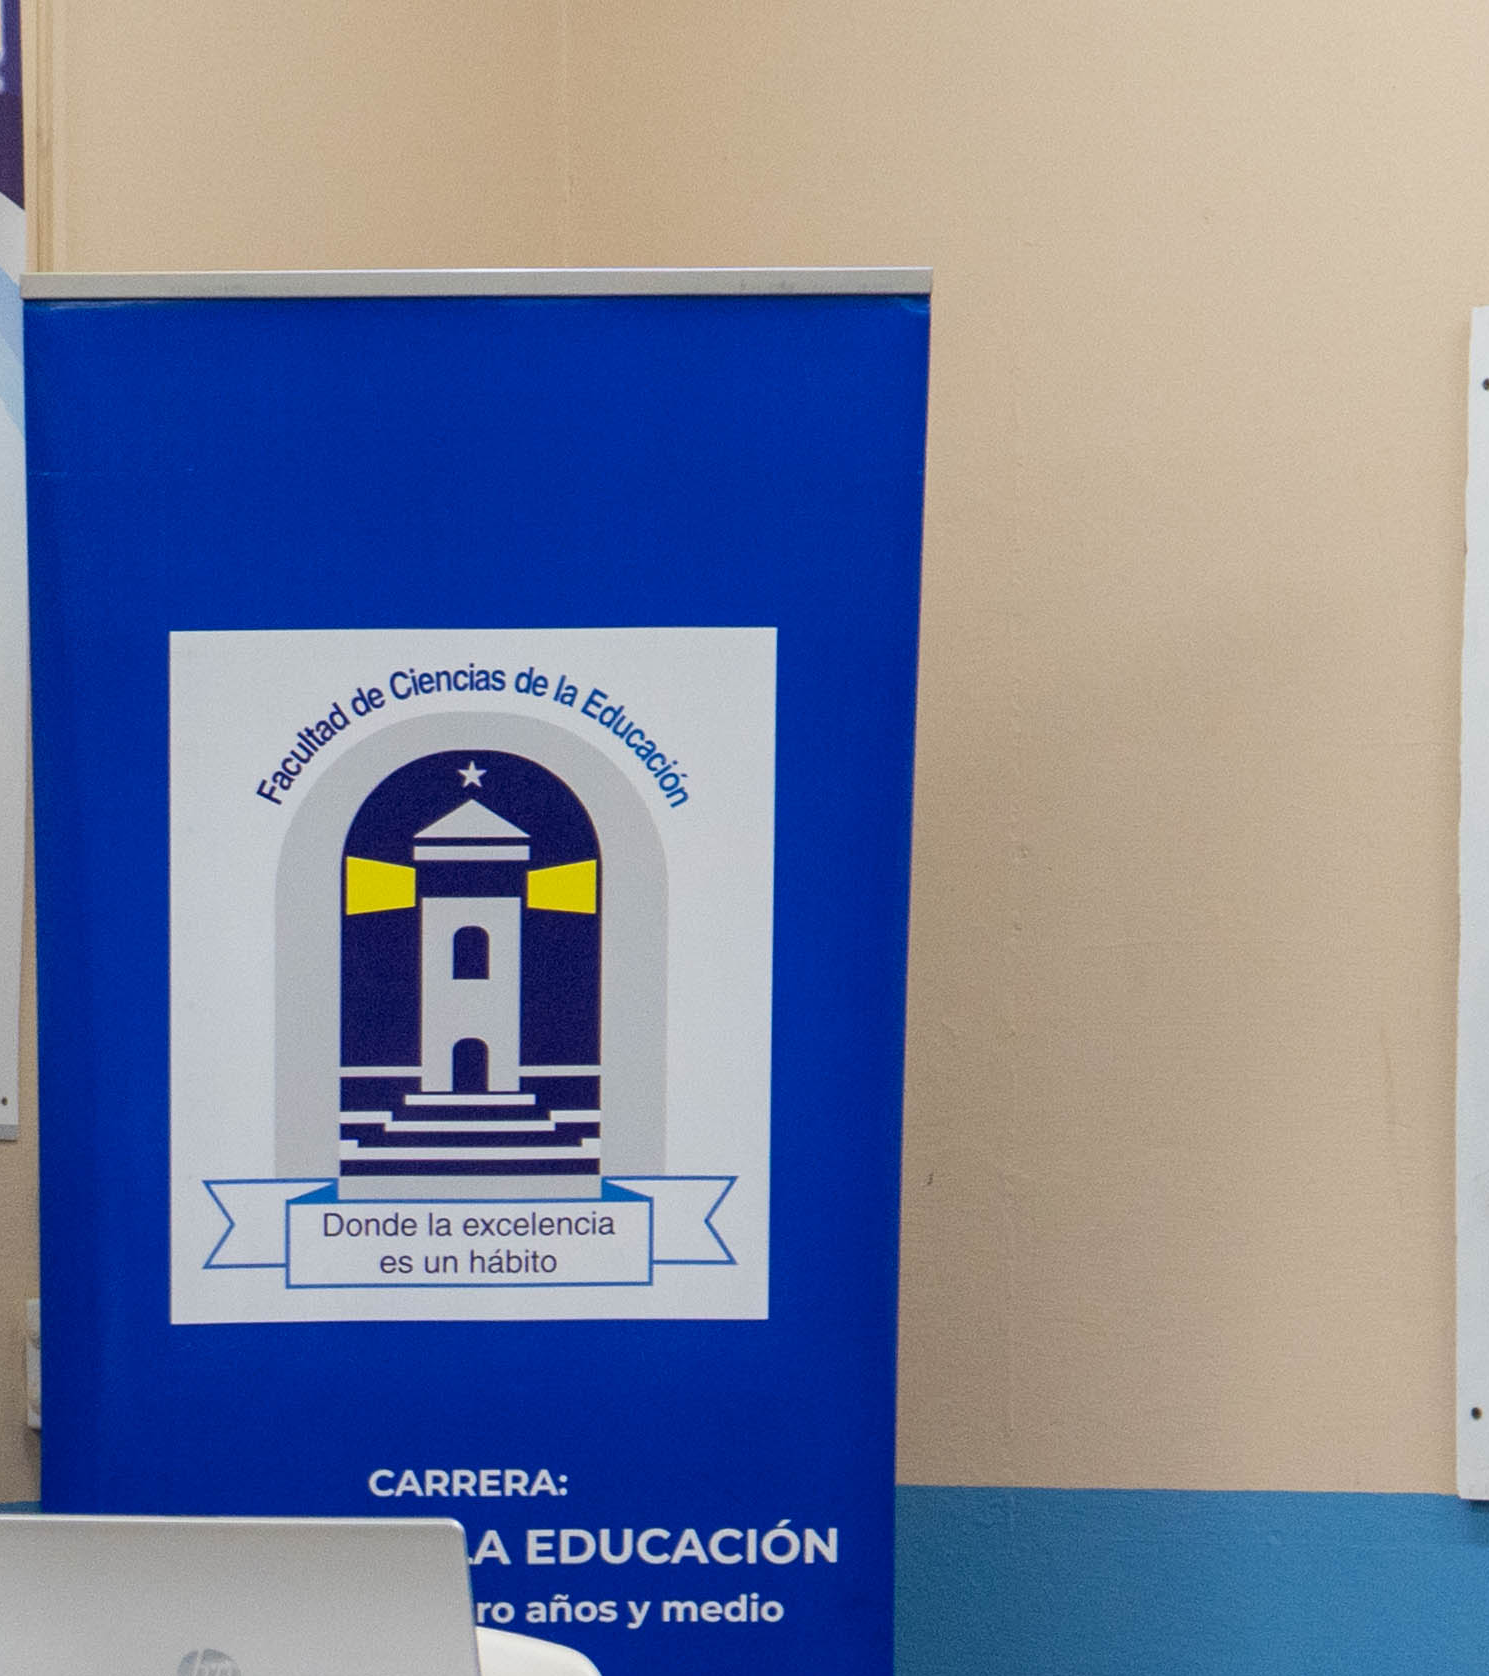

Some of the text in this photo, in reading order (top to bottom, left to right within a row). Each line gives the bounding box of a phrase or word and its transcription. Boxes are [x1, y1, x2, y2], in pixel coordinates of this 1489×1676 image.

[257, 663, 690, 809] Facultad de Ciencias de la Educación
[323, 1213, 615, 1237] Donde la excelencia
[379, 1247, 558, 1275] es un hábito
[368, 1469, 568, 1498] CARRERA:
[469, 1519, 838, 1565] A EDUCACIÓN
[525, 1594, 618, 1623] años
[626, 1601, 650, 1629] y
[661, 1593, 784, 1623] medio
